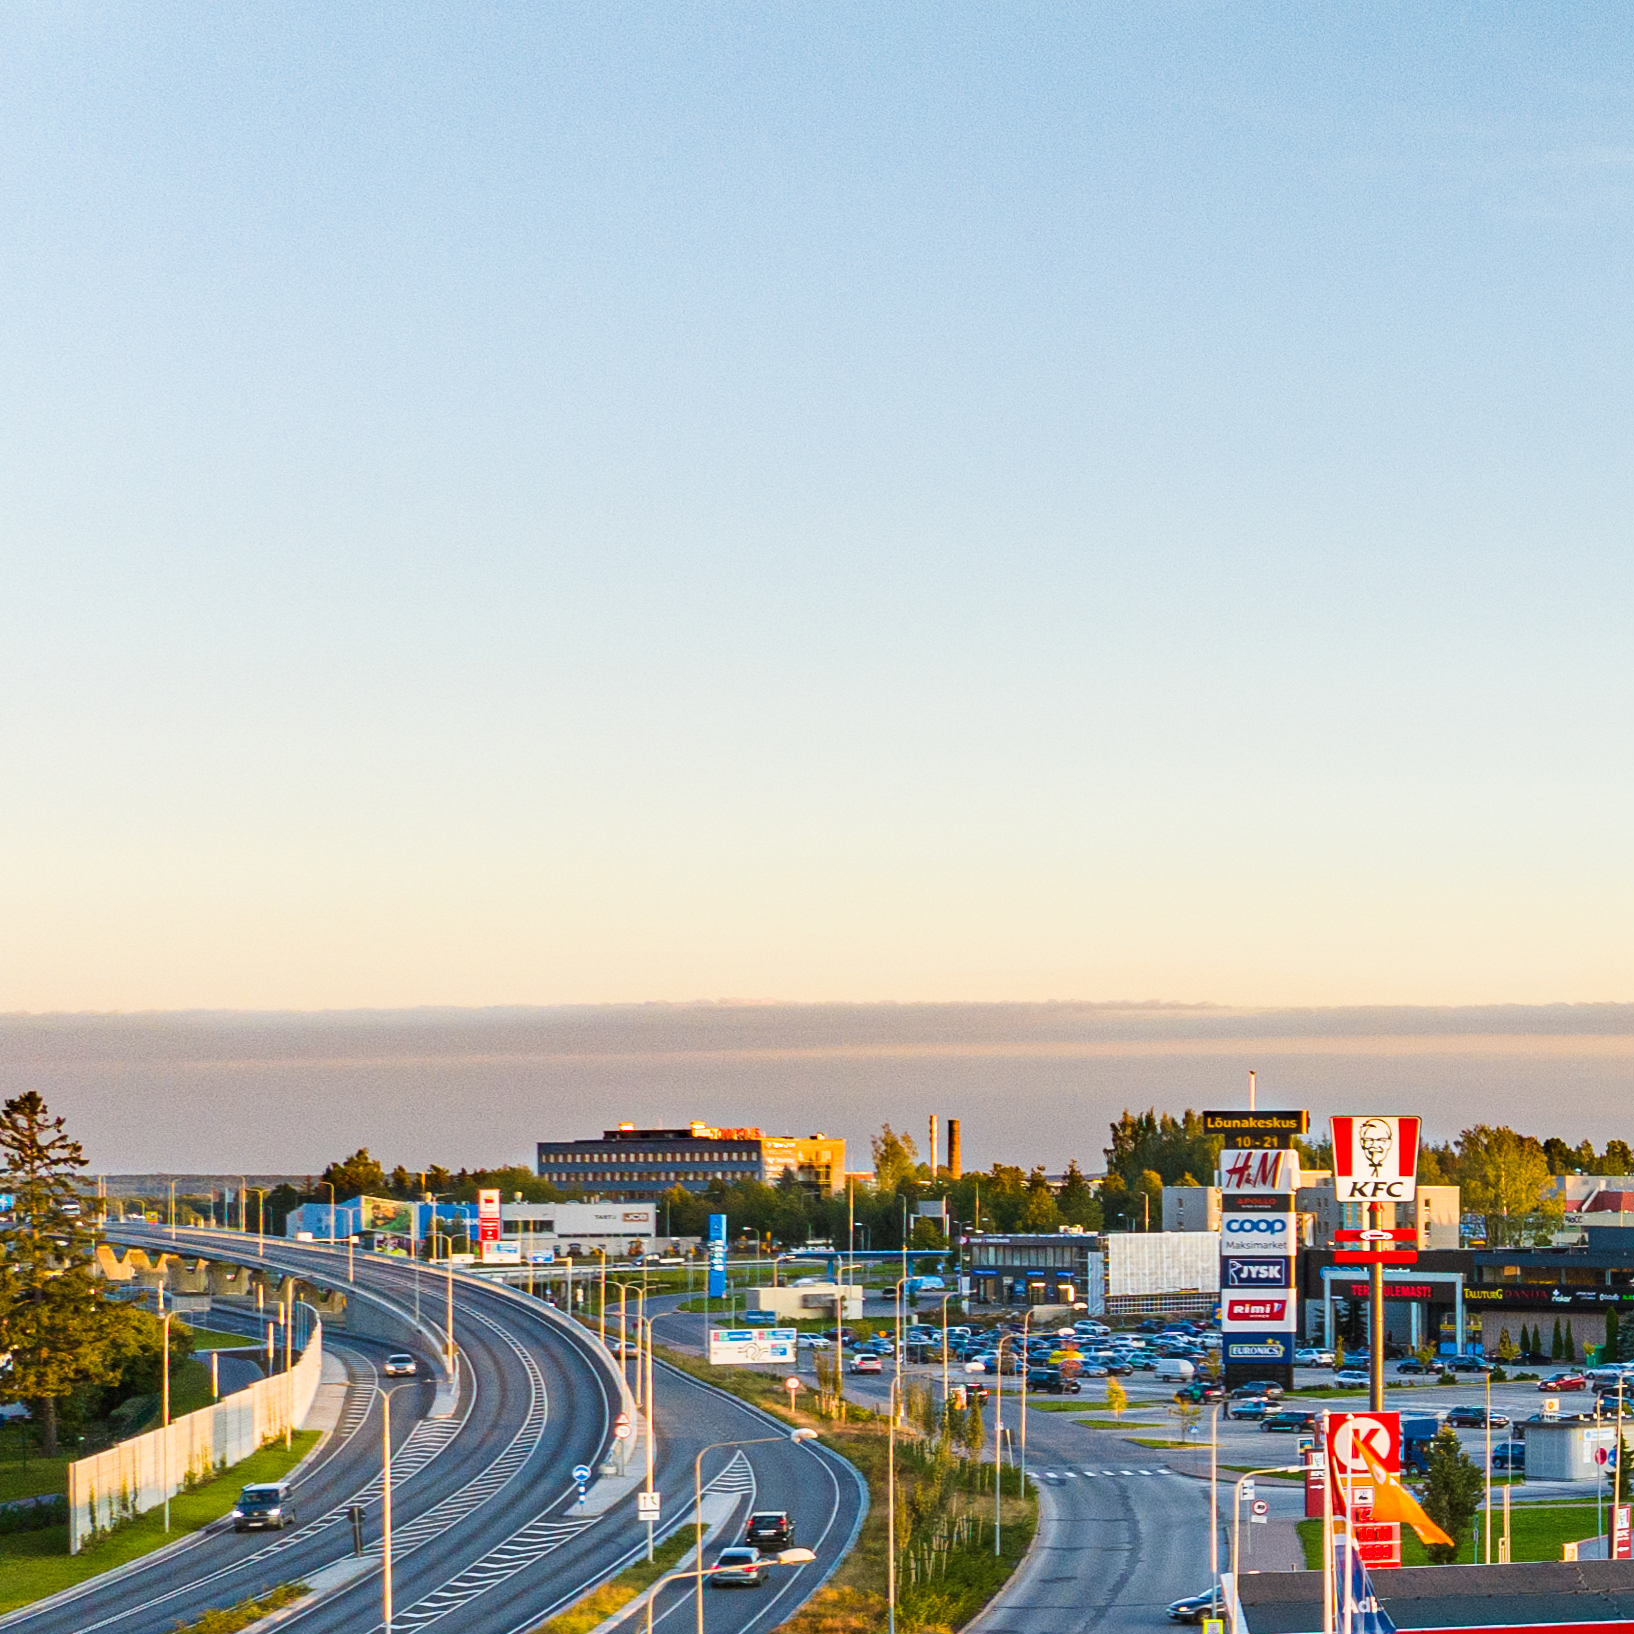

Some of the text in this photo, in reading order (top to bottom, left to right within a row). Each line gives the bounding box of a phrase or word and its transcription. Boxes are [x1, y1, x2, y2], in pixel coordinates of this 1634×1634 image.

[1206, 1116, 1298, 1129] Lõunakeskus
[1236, 1136, 1251, 1148] 10
[1263, 1136, 1278, 1148] 21
[1226, 1151, 1284, 1190] H&M
[1348, 1181, 1404, 1198] KFC
[1225, 1218, 1287, 1235] coop
[1226, 1241, 1288, 1250] Maksimarket
[1240, 1265, 1281, 1278] JYSK
[1233, 1303, 1271, 1314] Rimi
[1232, 1347, 1279, 1355] EURONICS
